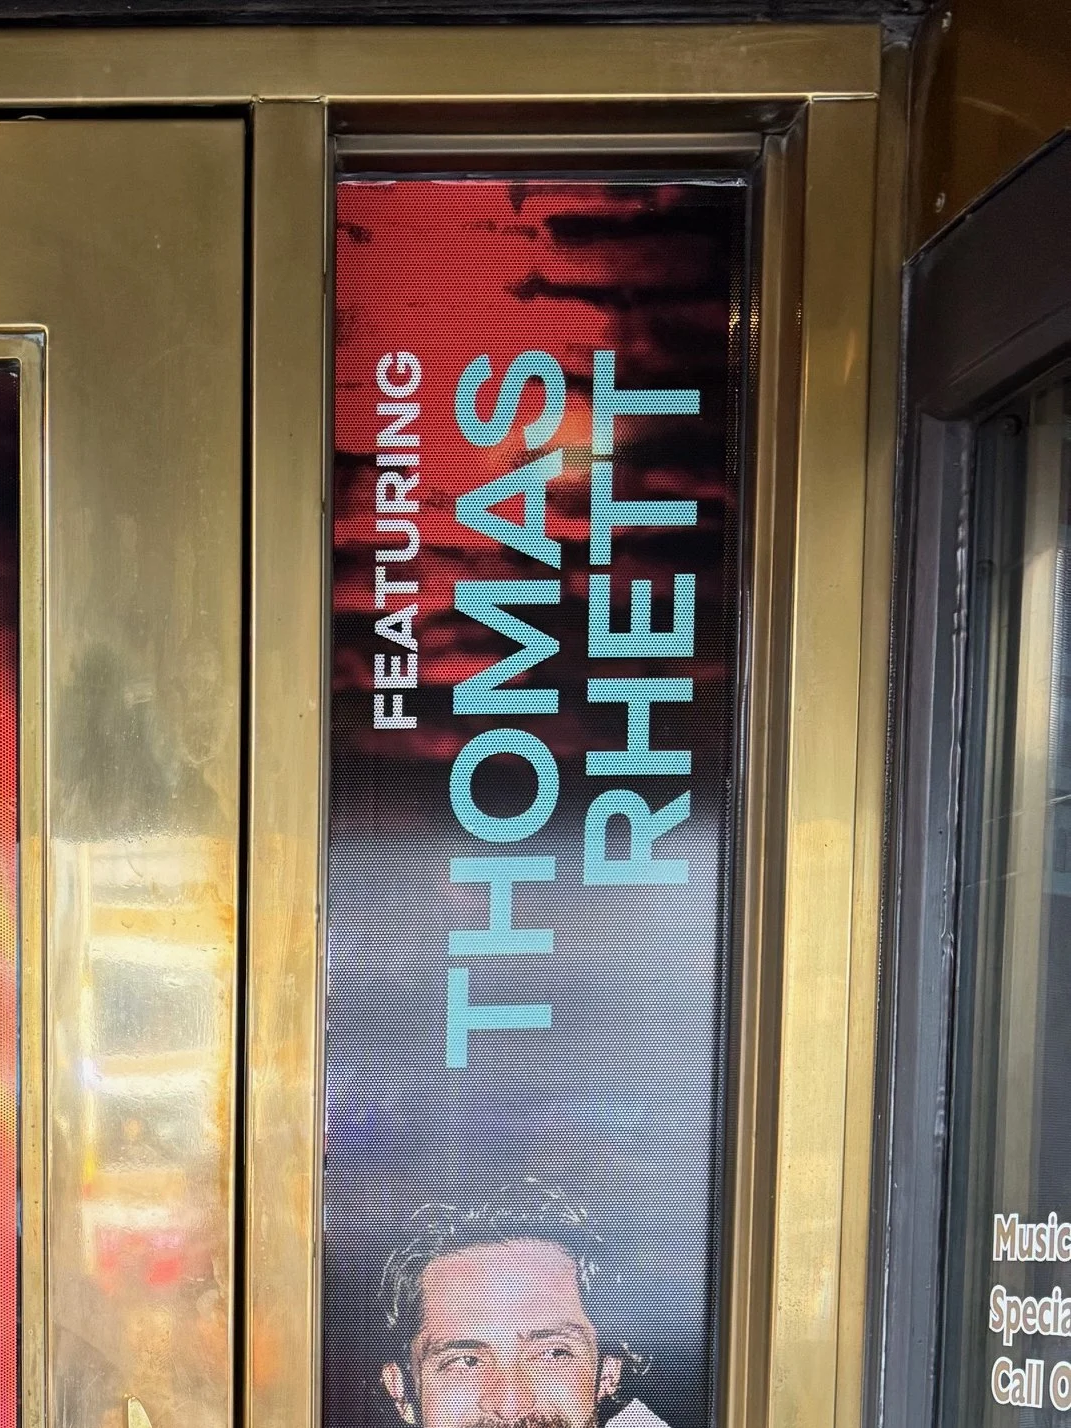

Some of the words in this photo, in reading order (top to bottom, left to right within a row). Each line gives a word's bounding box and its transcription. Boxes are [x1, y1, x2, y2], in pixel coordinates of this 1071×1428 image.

[373, 350, 422, 730] FEATURING
[446, 350, 567, 1068] THOMAS
[583, 350, 700, 886] RHETT
[991, 1356, 1044, 1409] Call
[993, 1211, 1071, 1262] Music
